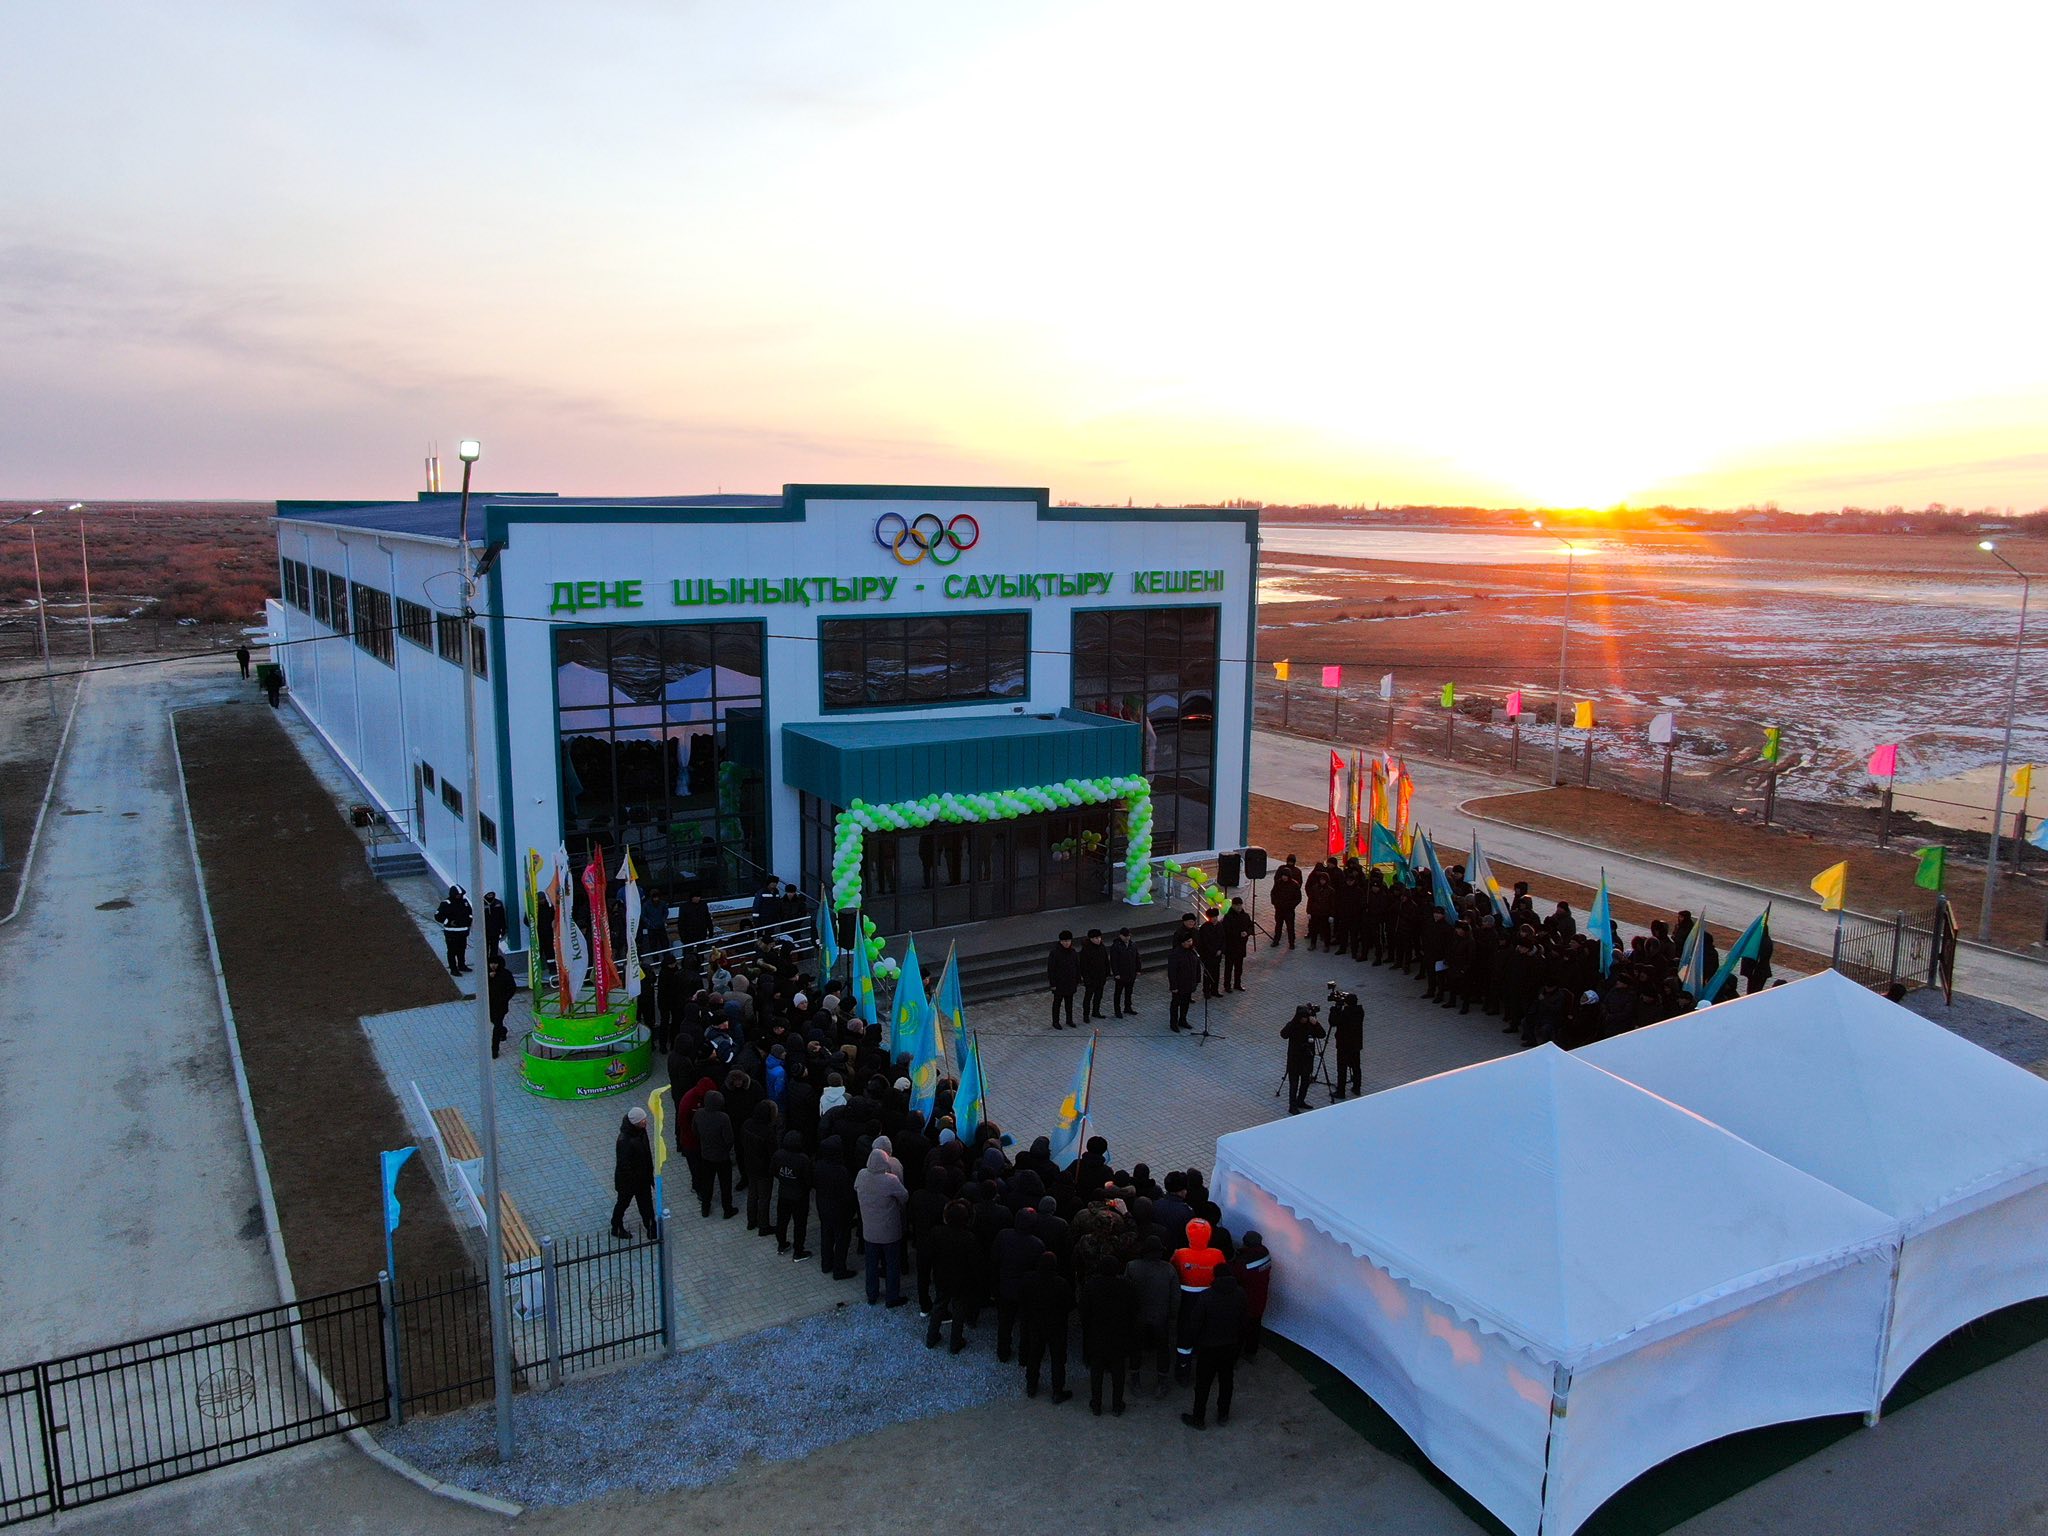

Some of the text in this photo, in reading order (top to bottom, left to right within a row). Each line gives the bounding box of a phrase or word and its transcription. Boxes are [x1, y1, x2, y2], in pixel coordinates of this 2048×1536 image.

[548, 580, 644, 615] ДЕНЕ
[672, 576, 898, 607] ШЫНЫҚТЫРУ
[944, 571, 1114, 600] САУЫҚТЫРУ
[1132, 569, 1224, 593] КЕШЕНІ
